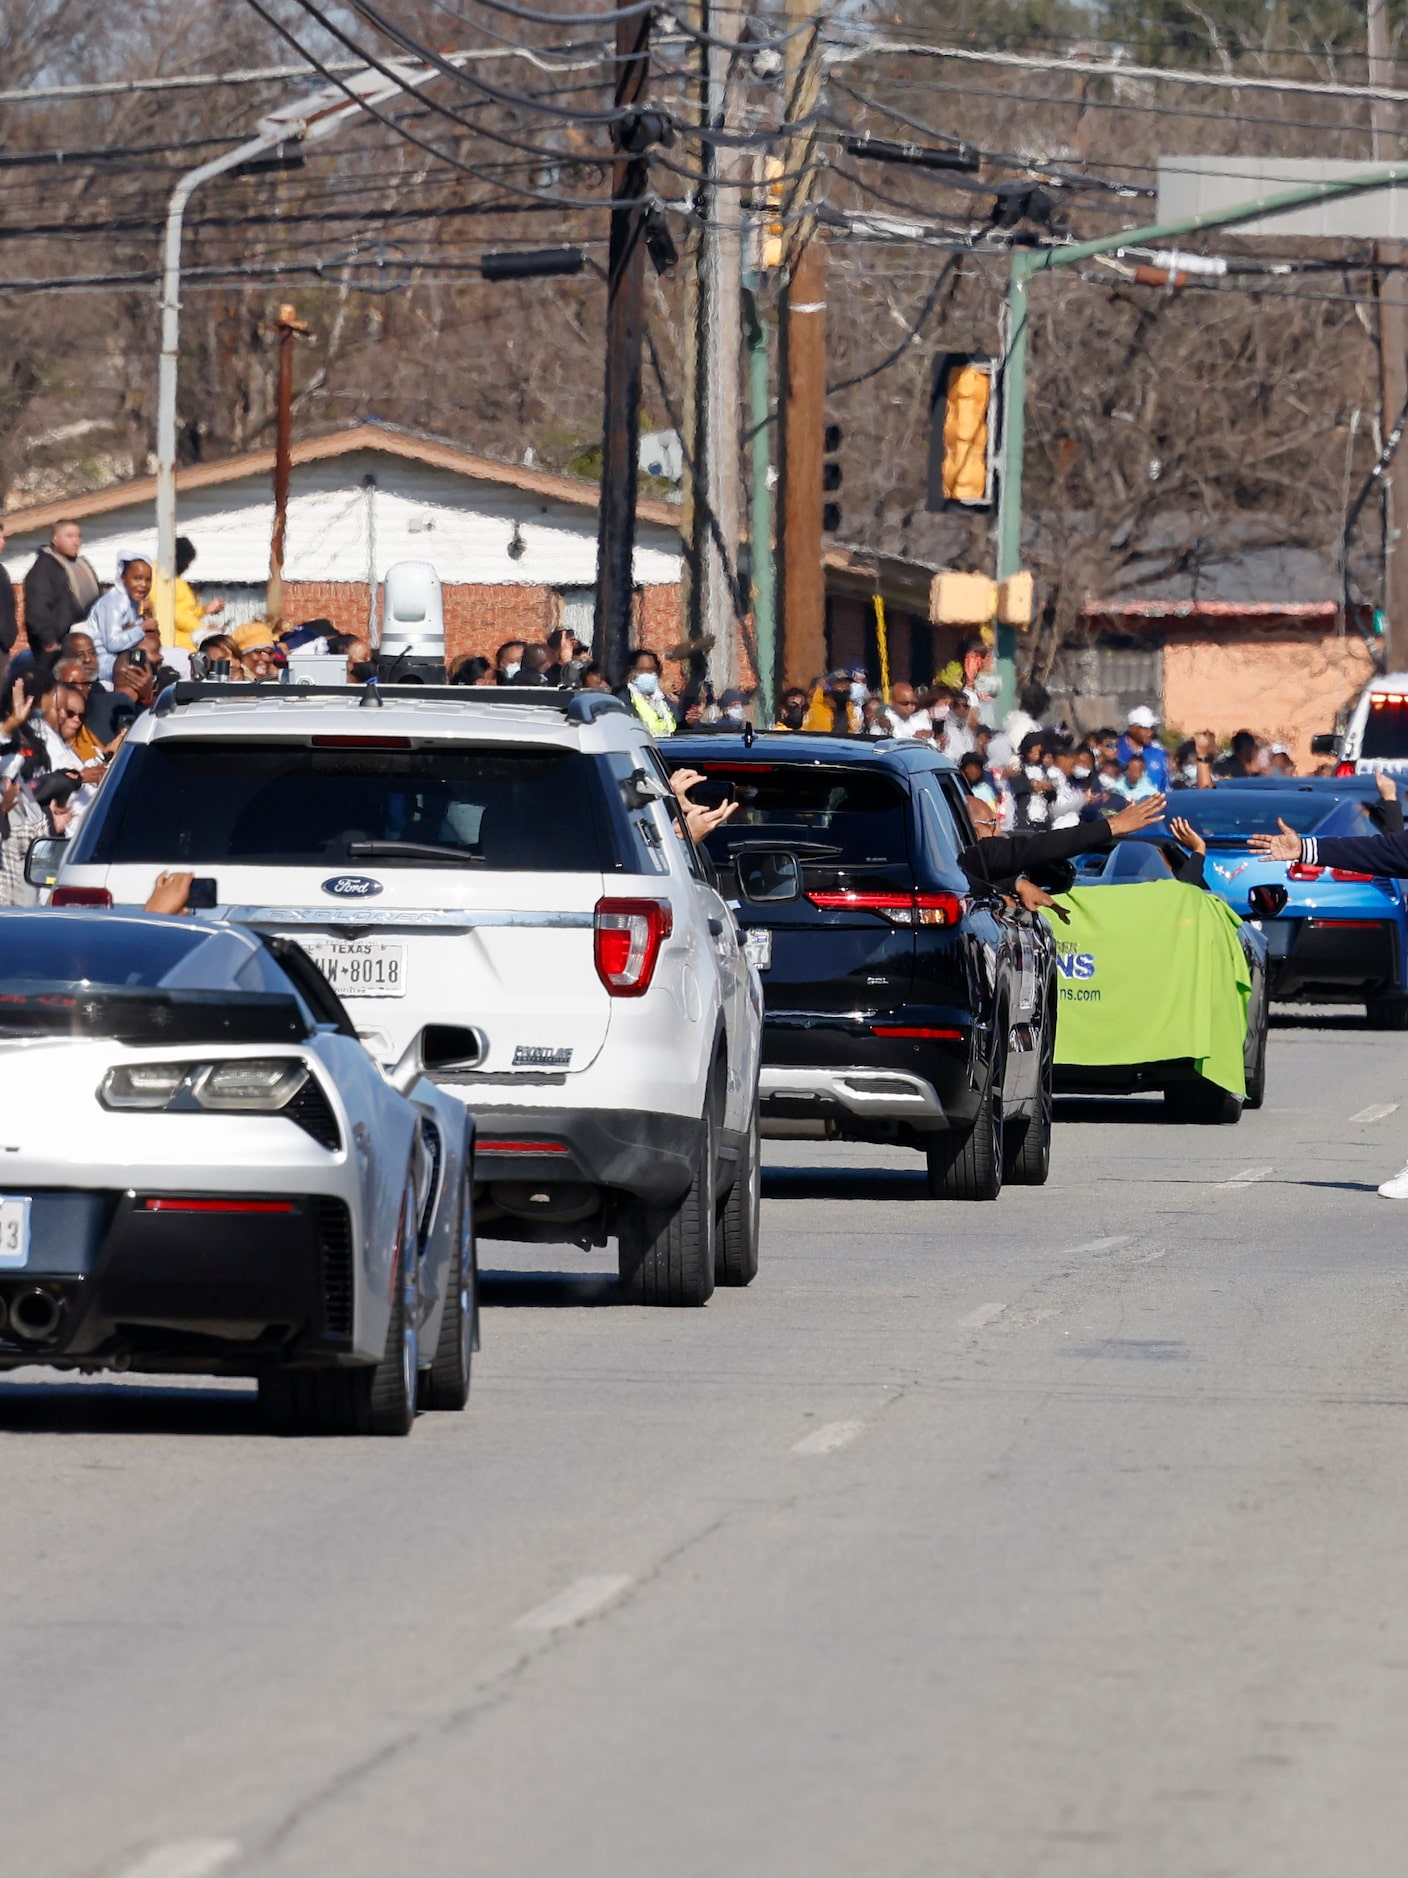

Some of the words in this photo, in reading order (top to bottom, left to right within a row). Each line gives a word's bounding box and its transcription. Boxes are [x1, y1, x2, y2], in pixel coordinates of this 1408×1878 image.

[334, 878, 370, 893] Ford
[269, 910, 438, 923] EXPLORER
[331, 944, 371, 954] TEXAS
